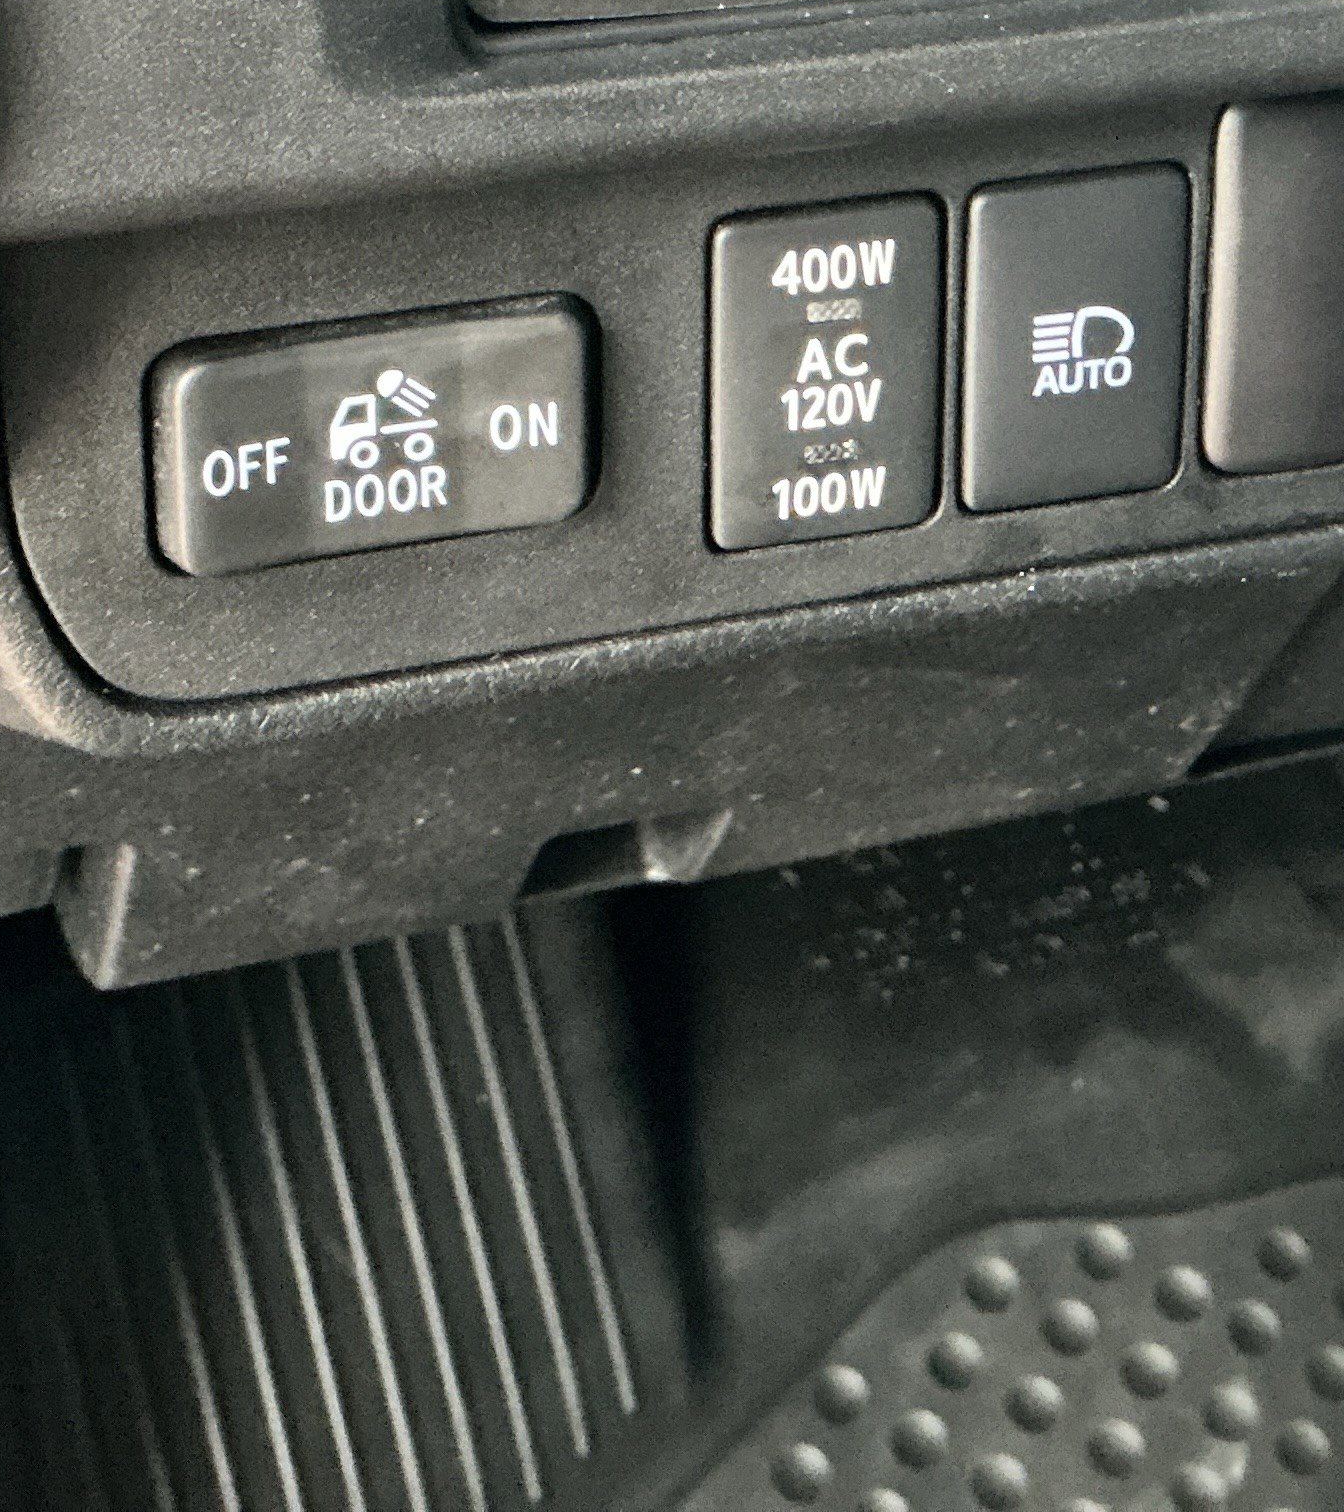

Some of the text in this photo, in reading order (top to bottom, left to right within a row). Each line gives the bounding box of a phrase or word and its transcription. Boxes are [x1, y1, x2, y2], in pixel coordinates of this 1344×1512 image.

[772, 238, 896, 296] 400W
[796, 333, 870, 384] AC
[1032, 355, 1133, 398] AUTO
[489, 401, 559, 452] ON
[780, 378, 883, 432] 120V
[203, 436, 291, 498] OFF
[324, 464, 449, 524] DOOR
[772, 465, 887, 522] 100W
